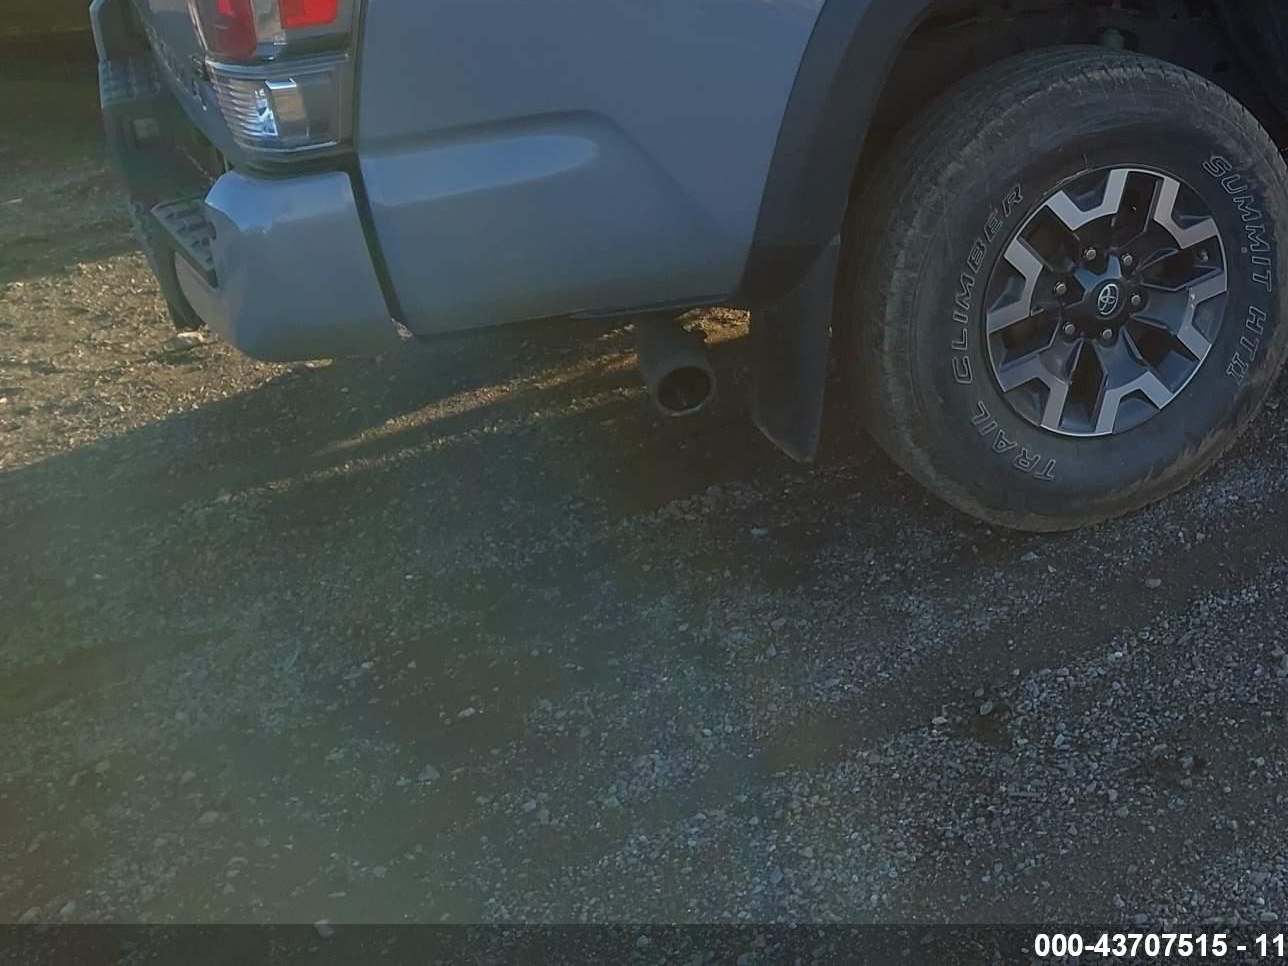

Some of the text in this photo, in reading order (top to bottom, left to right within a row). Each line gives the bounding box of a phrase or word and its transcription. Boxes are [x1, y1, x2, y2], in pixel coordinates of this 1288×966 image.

[1202, 153, 1273, 293] SUMMIT
[951, 184, 1058, 481] TRAIL CLIMBER
